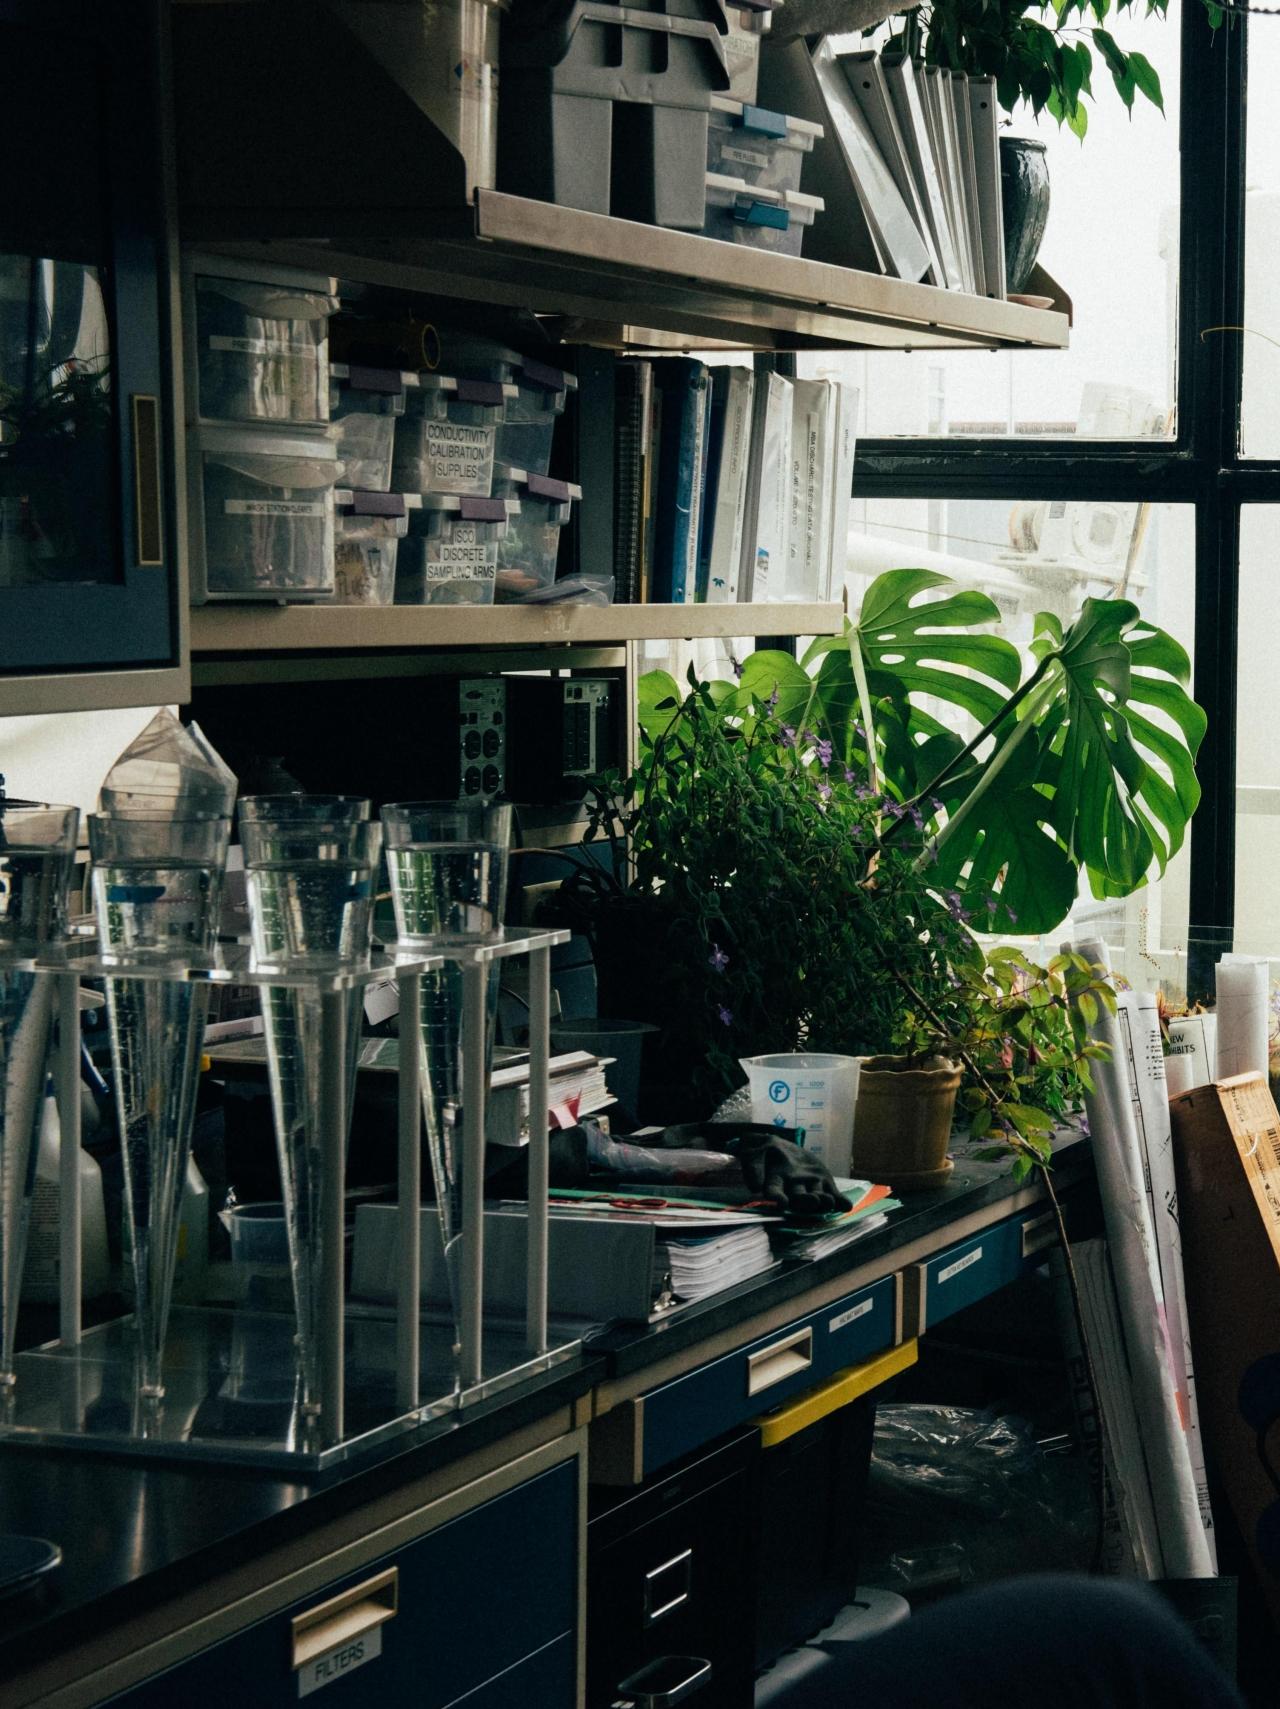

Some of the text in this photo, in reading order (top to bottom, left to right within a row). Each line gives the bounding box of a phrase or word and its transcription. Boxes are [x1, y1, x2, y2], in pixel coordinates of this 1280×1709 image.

[428, 424, 490, 442] CONDUCTIVITY
[429, 443, 485, 461] CALIBRATION
[437, 461, 477, 479] SUPPLIES
[807, 446, 816, 485] DISCHAR
[454, 529, 474, 544] ISCO
[444, 547, 484, 562] DISCRETE
[427, 565, 495, 580] SAMPLING ARMS
[315, 1642, 364, 1682] FILTERS
